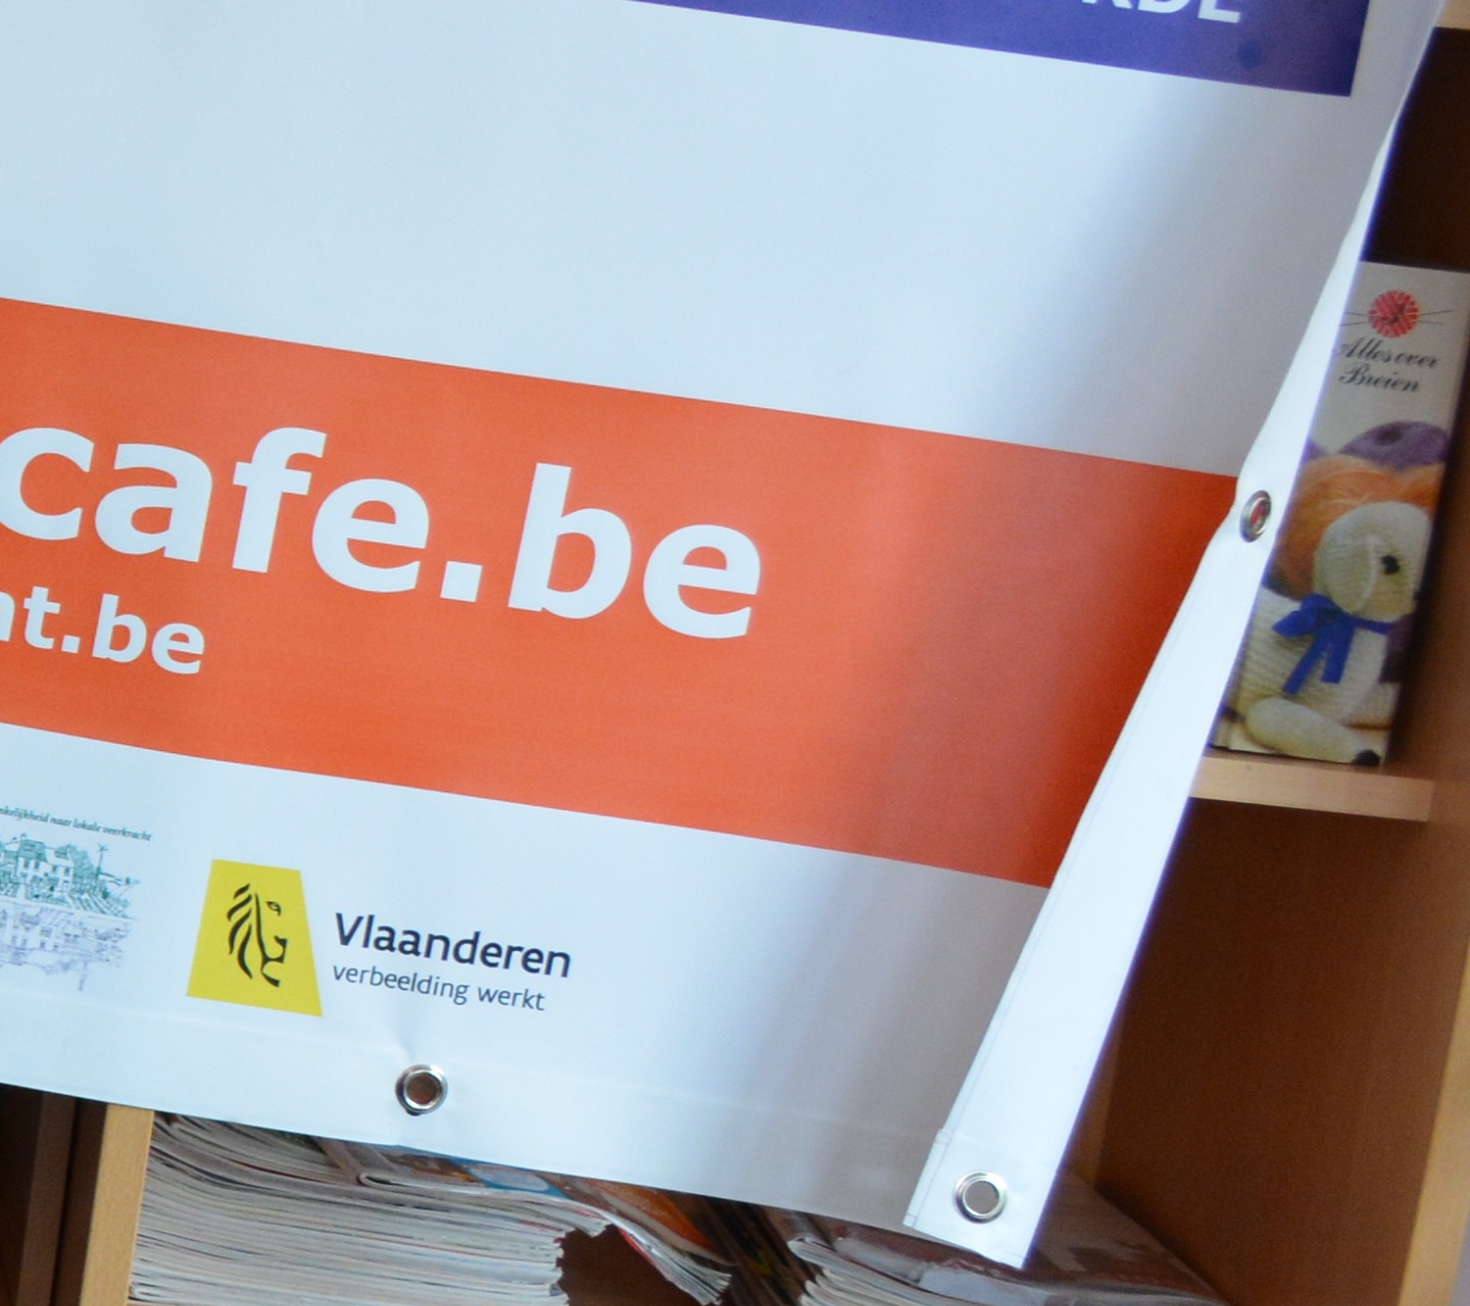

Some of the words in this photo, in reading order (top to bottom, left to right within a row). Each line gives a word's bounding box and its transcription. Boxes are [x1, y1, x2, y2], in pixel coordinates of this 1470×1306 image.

[1337, 336, 1392, 363] Alles
[1394, 351, 1438, 369] over
[1338, 363, 1421, 393] Breien
[50, 815, 72, 827] naar
[334, 912, 572, 980] Vlaanderen
[332, 963, 469, 1006] verbeelding
[477, 983, 547, 1012] werkt
